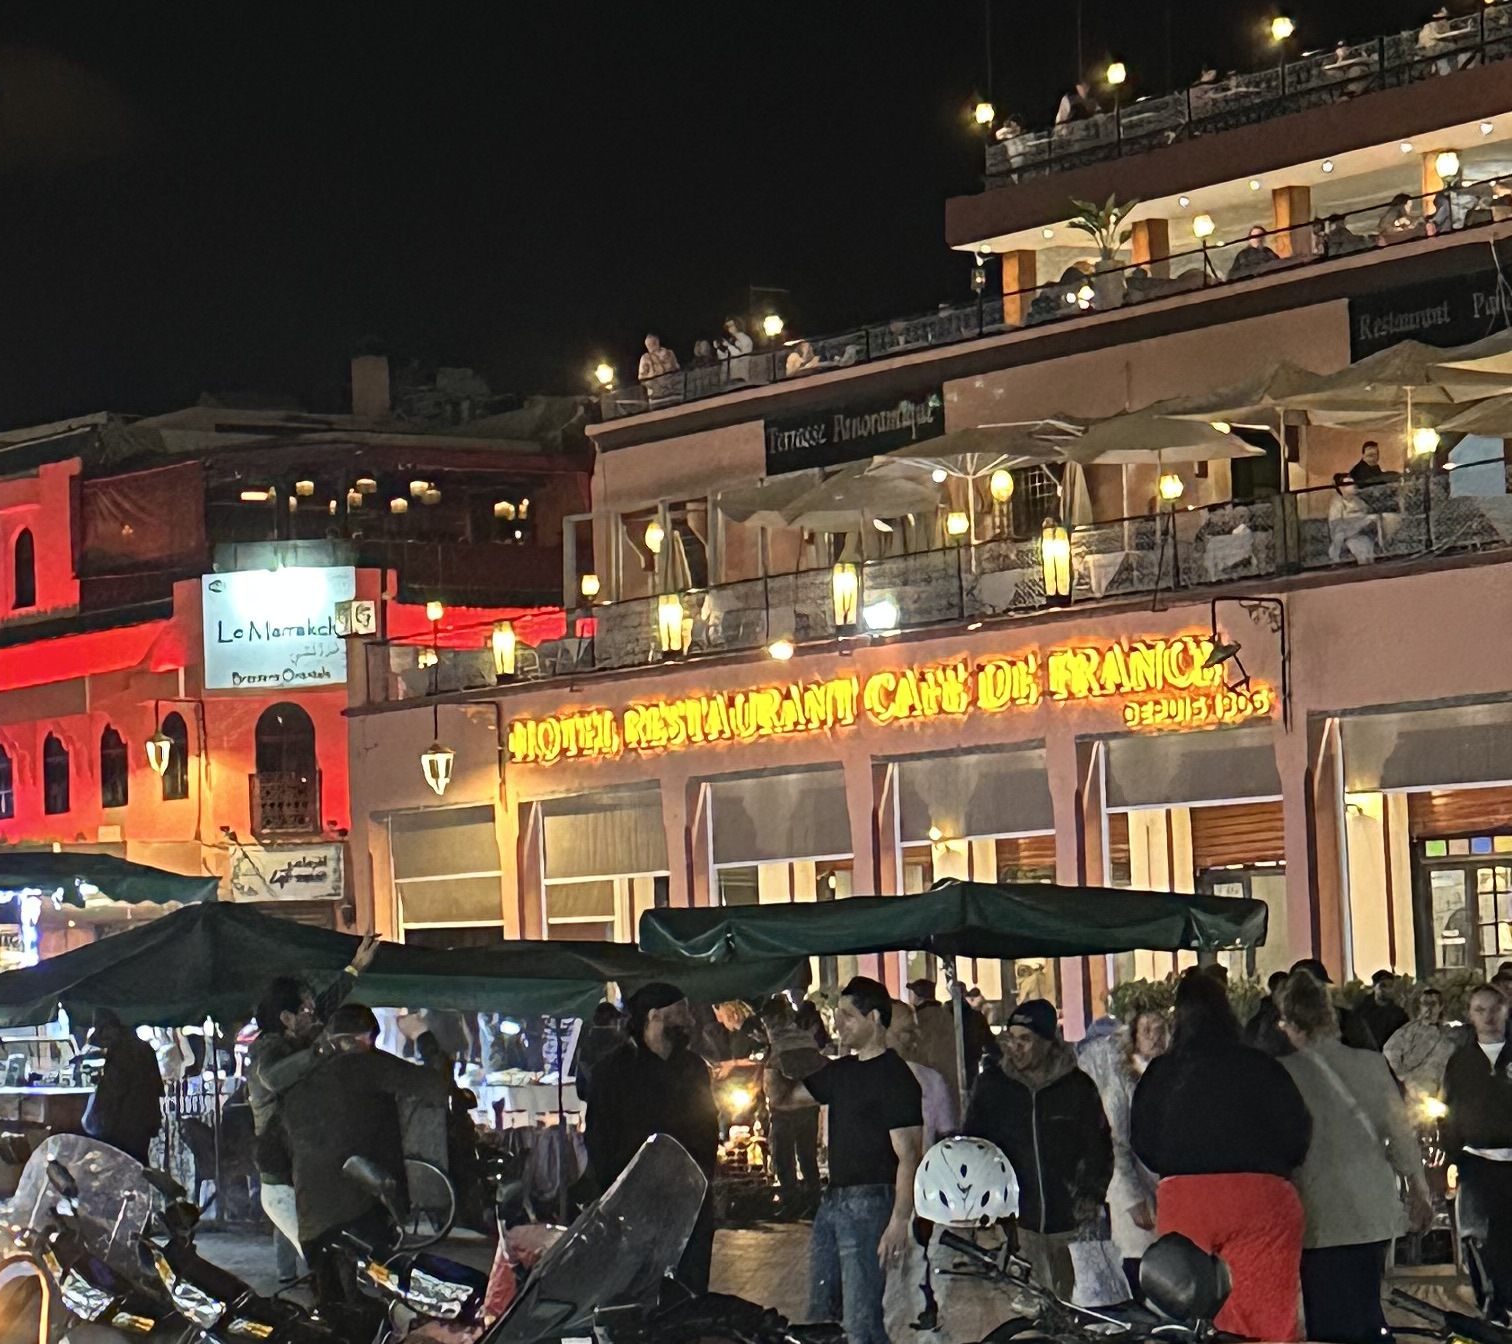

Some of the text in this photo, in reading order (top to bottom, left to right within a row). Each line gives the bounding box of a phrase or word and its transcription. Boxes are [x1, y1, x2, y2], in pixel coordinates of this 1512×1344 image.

[508, 710, 620, 762] HOTEL
[623, 676, 859, 749] RESTAURANT
[977, 653, 1043, 712] DE
